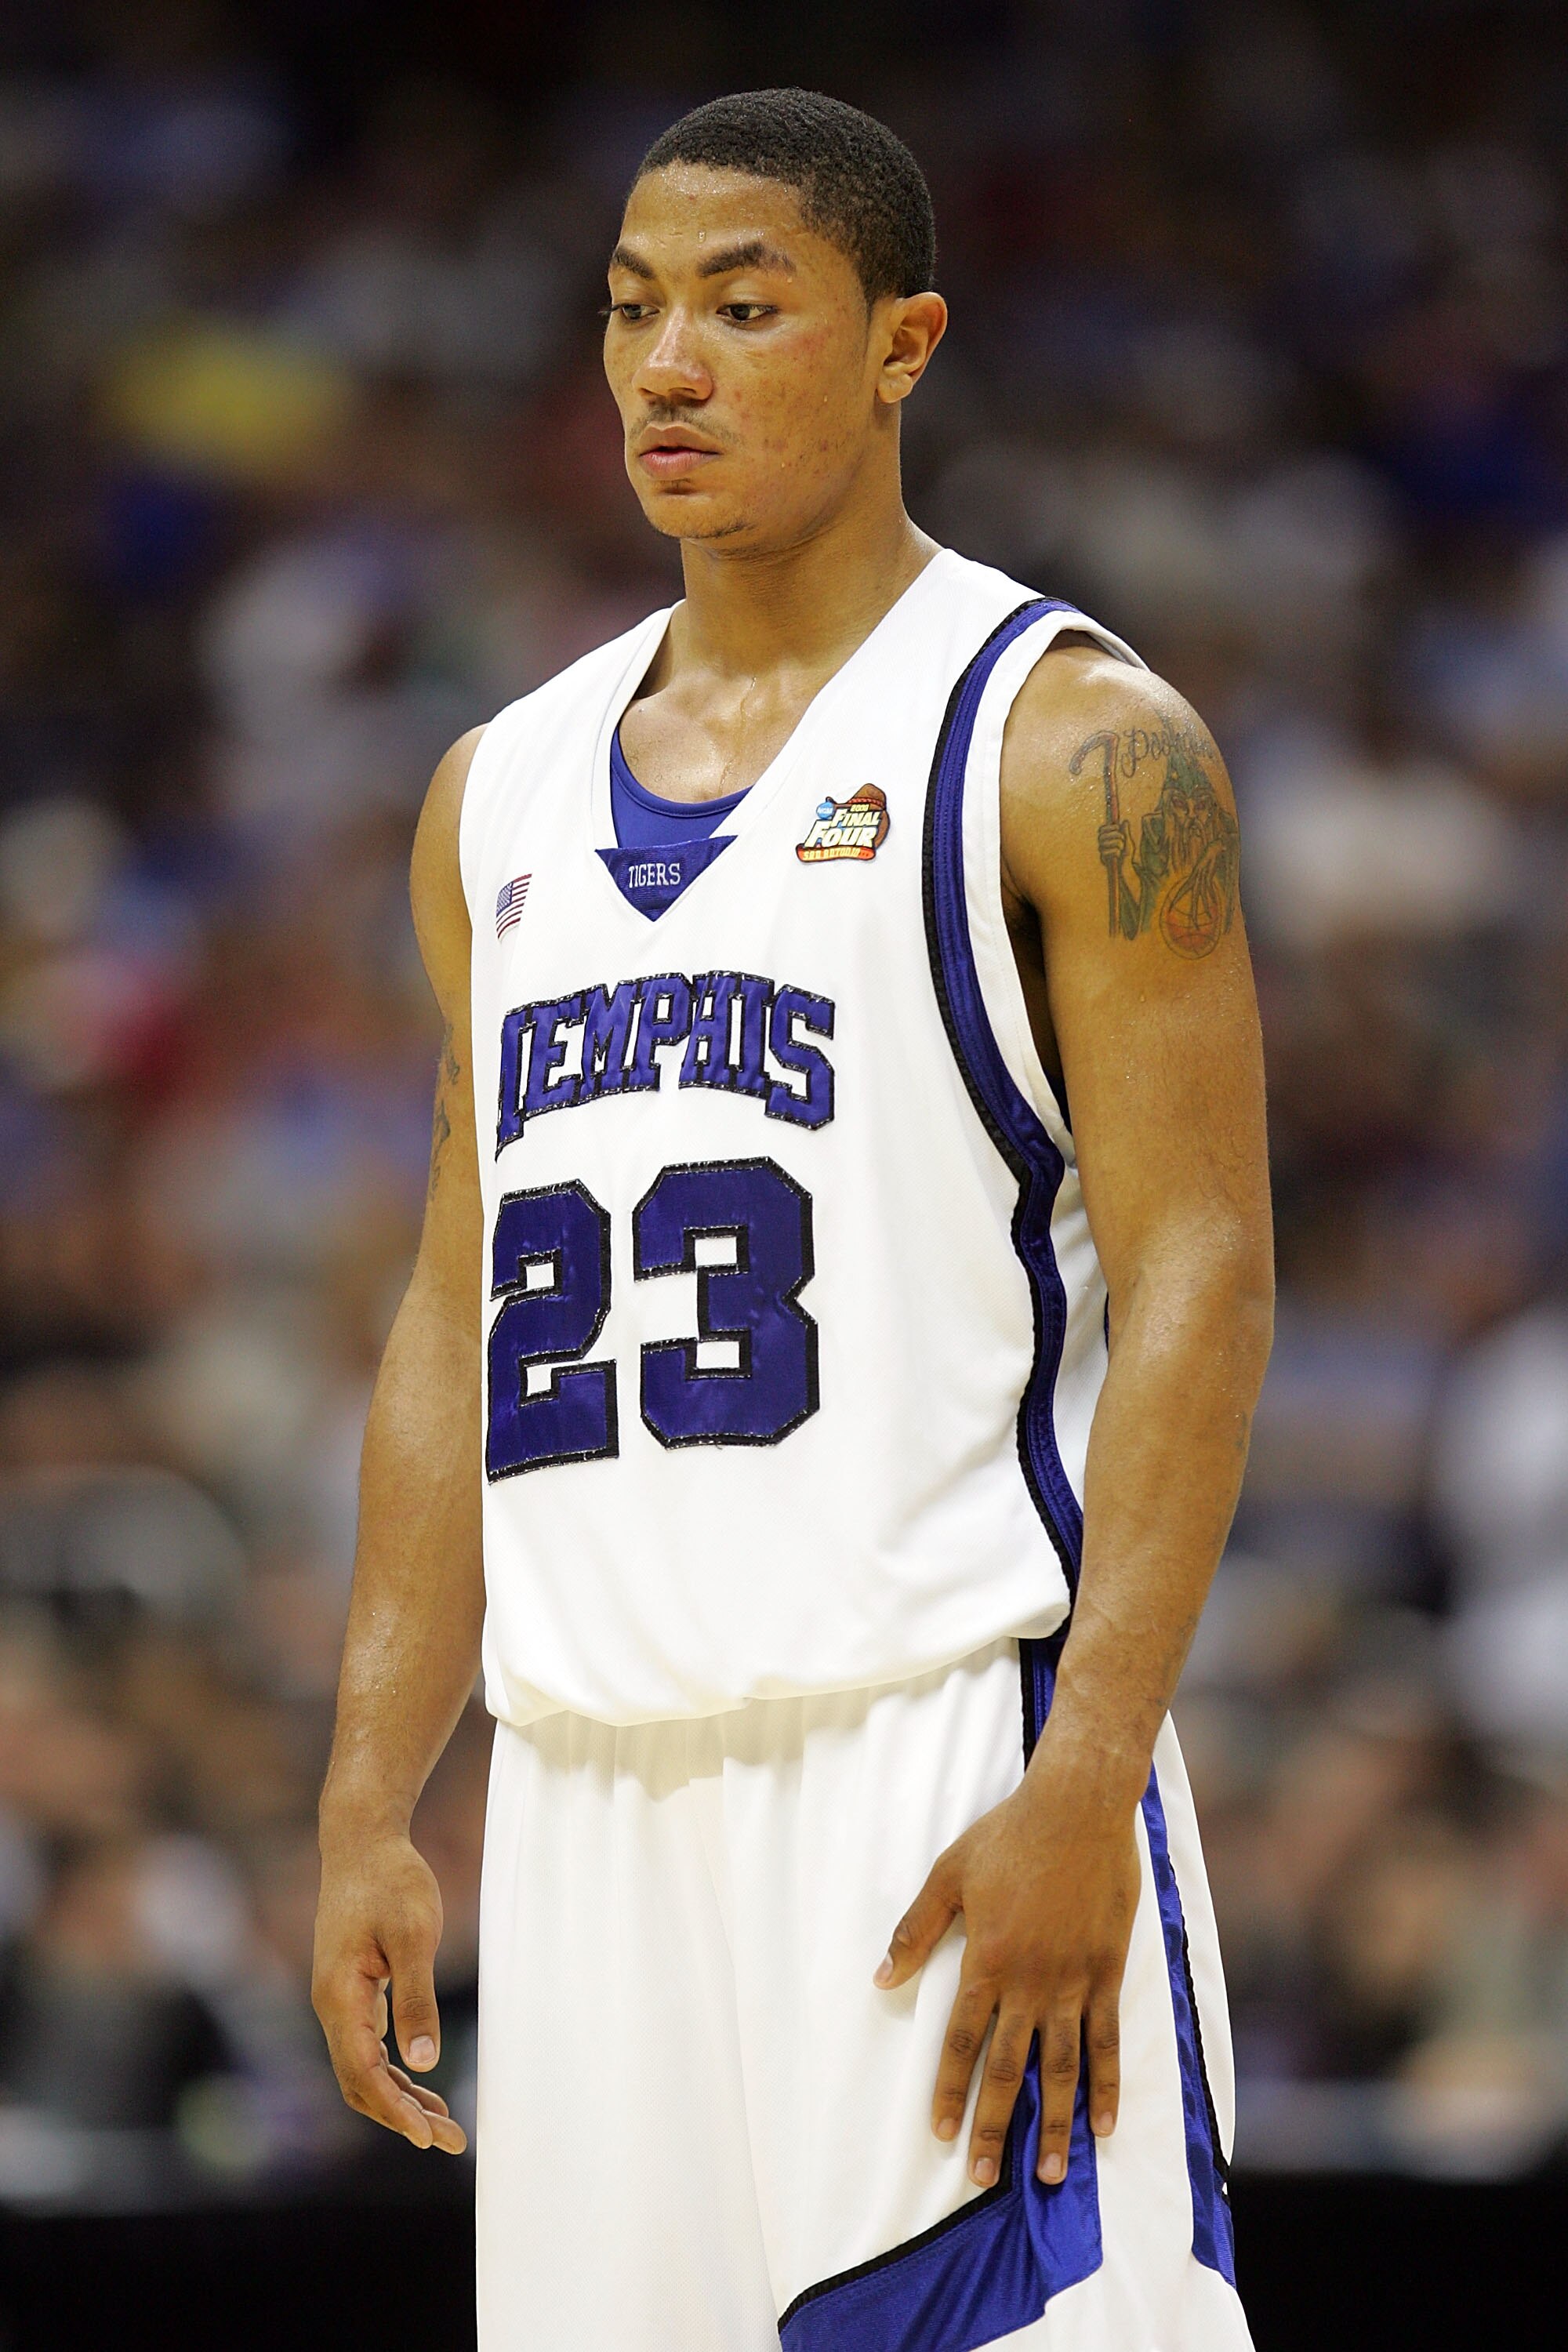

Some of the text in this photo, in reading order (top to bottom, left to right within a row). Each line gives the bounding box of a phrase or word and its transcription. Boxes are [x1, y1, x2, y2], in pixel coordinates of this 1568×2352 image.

[830, 808, 880, 827] FINAL
[804, 821, 877, 848] FOUR
[629, 862, 681, 888] TIGERS
[485, 1156, 820, 1485] 23
